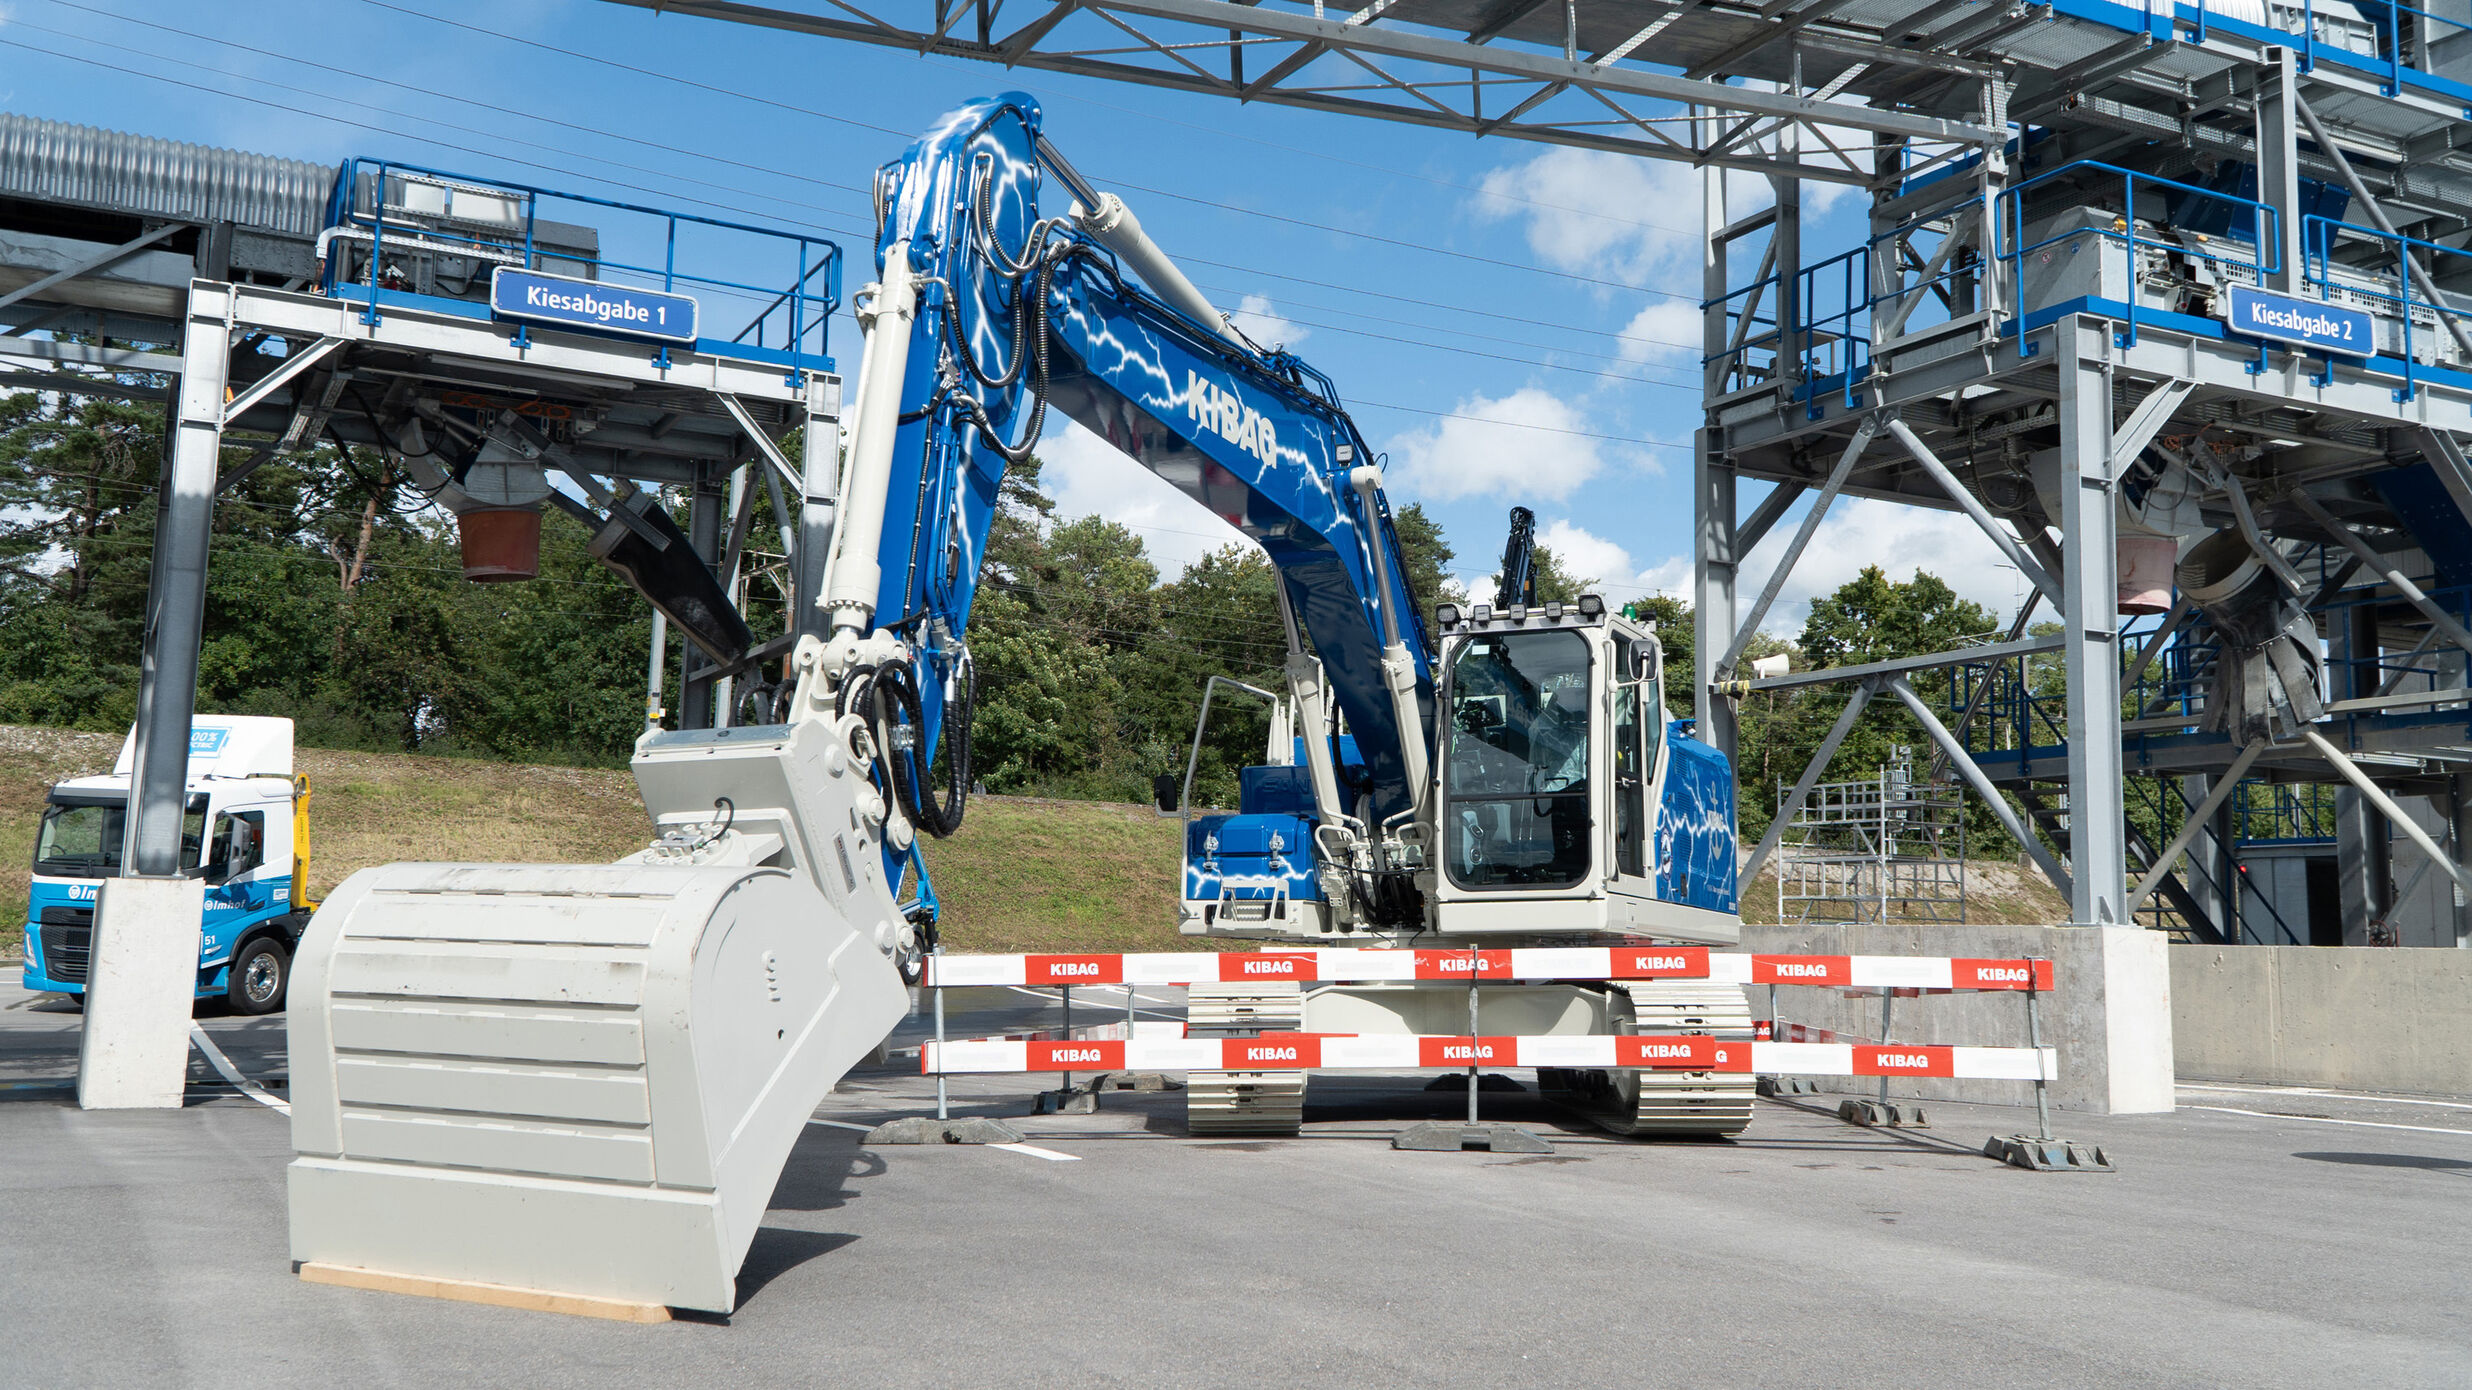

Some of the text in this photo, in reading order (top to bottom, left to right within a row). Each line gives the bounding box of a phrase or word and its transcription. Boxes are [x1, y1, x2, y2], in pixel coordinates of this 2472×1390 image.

[527, 285, 666, 325] Kiesabgabe 1
[2252, 302, 2353, 341] Kiesabgabe 2
[1188, 368, 1277, 470] KIBAG
[191, 731, 219, 742] 00%
[1263, 777, 1312, 795] SAN
[213, 899, 246, 911] Imhof
[204, 935, 216, 946] 51
[1050, 962, 1099, 976] KIBAG
[1244, 960, 1293, 974] KIBAG
[1439, 958, 1489, 972] KIBAG
[1635, 956, 1686, 970] KIBAG
[1776, 964, 1827, 977] KIBAG
[1977, 967, 2028, 982] KIBAG
[1052, 1048, 1101, 1062] KIBAG
[1247, 1047, 1297, 1061] KIBAG
[1443, 1045, 1493, 1059] KIBAG
[1641, 1044, 1691, 1058] KIBAG
[1877, 1054, 1928, 1068] KIBAG
